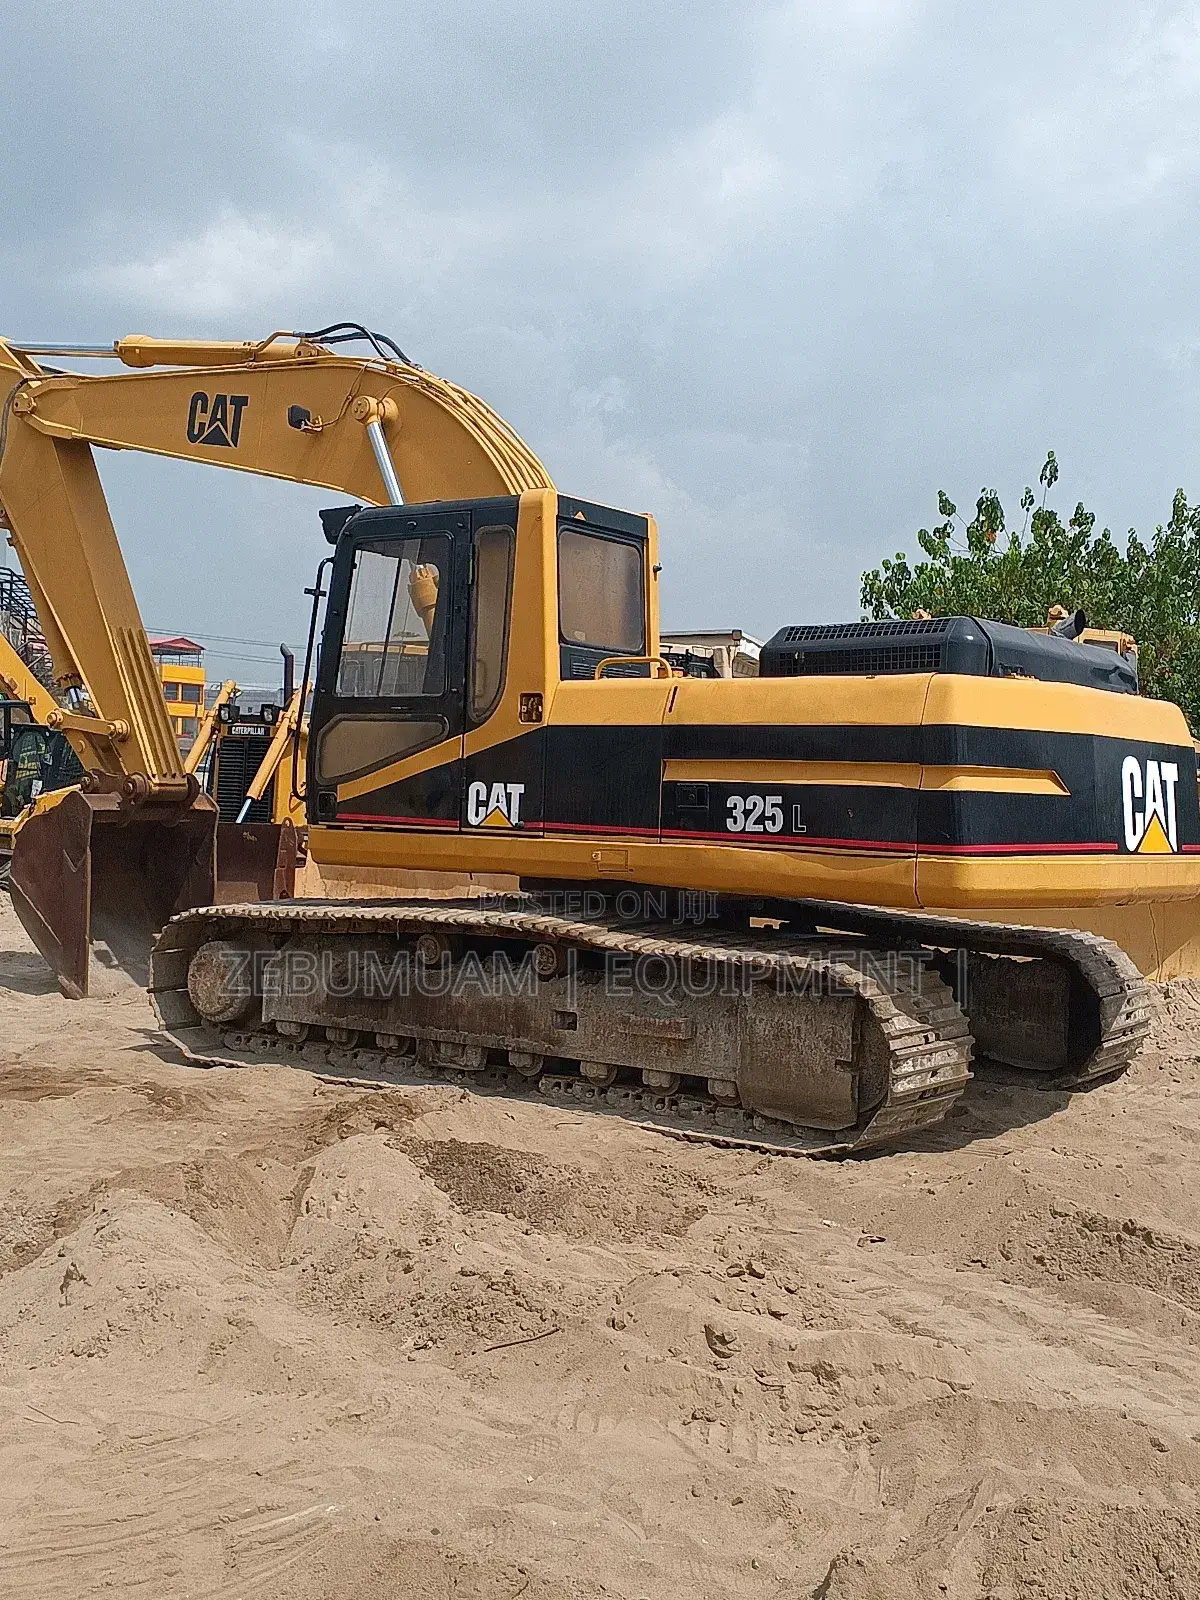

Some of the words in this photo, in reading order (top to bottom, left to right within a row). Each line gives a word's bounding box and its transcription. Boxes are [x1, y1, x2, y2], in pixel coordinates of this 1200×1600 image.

[187, 391, 249, 448] CAT
[231, 726, 265, 736] CATERPILLAR
[467, 781, 525, 827] CAT
[726, 795, 784, 833] 325
[792, 804, 807, 833] L
[1121, 755, 1179, 853] CAT
